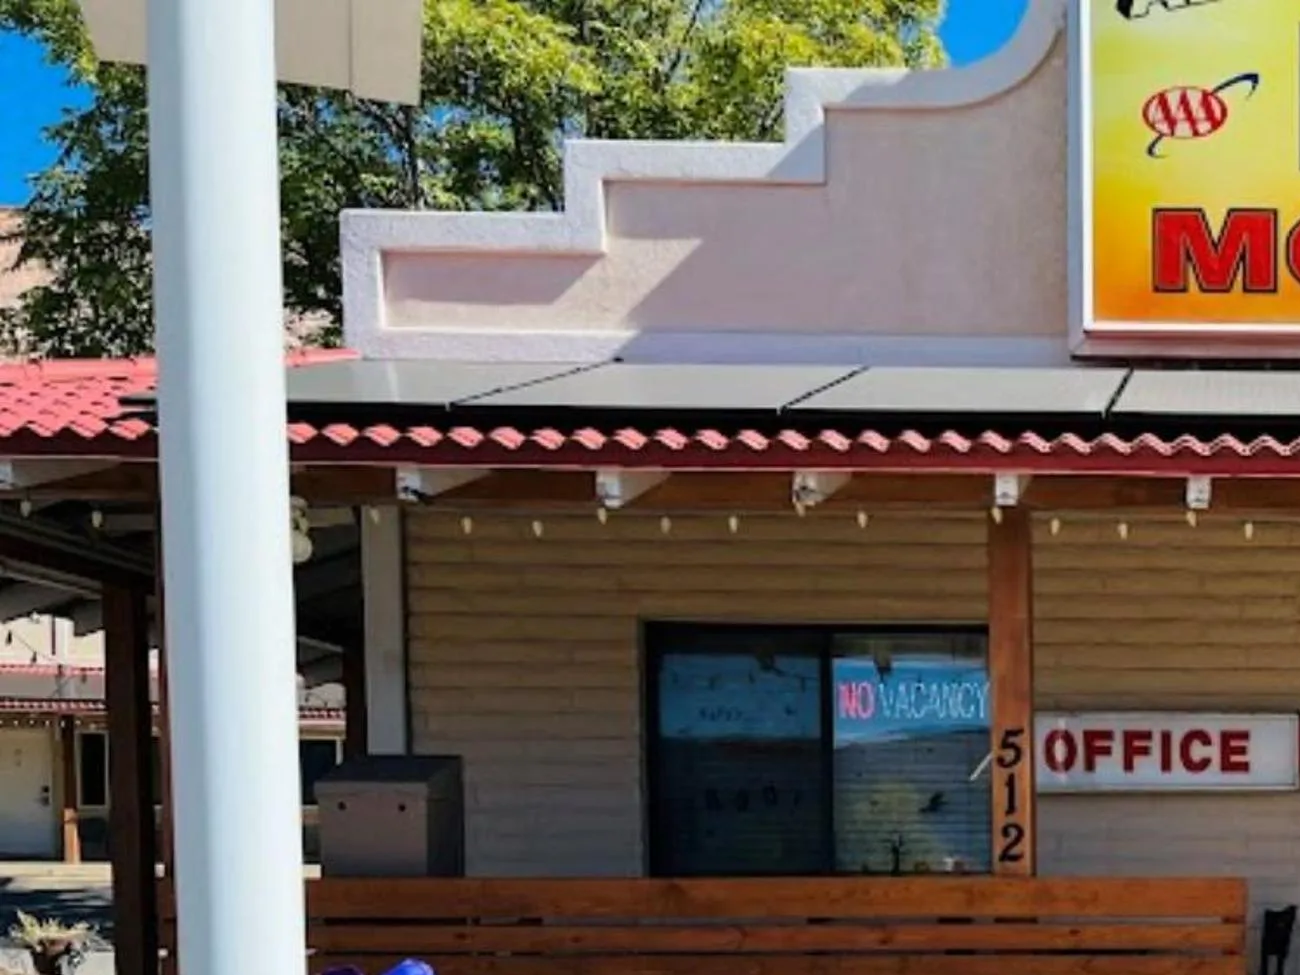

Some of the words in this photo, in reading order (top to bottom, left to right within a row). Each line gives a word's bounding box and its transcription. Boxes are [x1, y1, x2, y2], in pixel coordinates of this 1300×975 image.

[1149, 87, 1224, 138] AAA
[838, 681, 875, 719] NO
[879, 682, 990, 719] VACANCY
[1044, 729, 1251, 773] OFFICE
